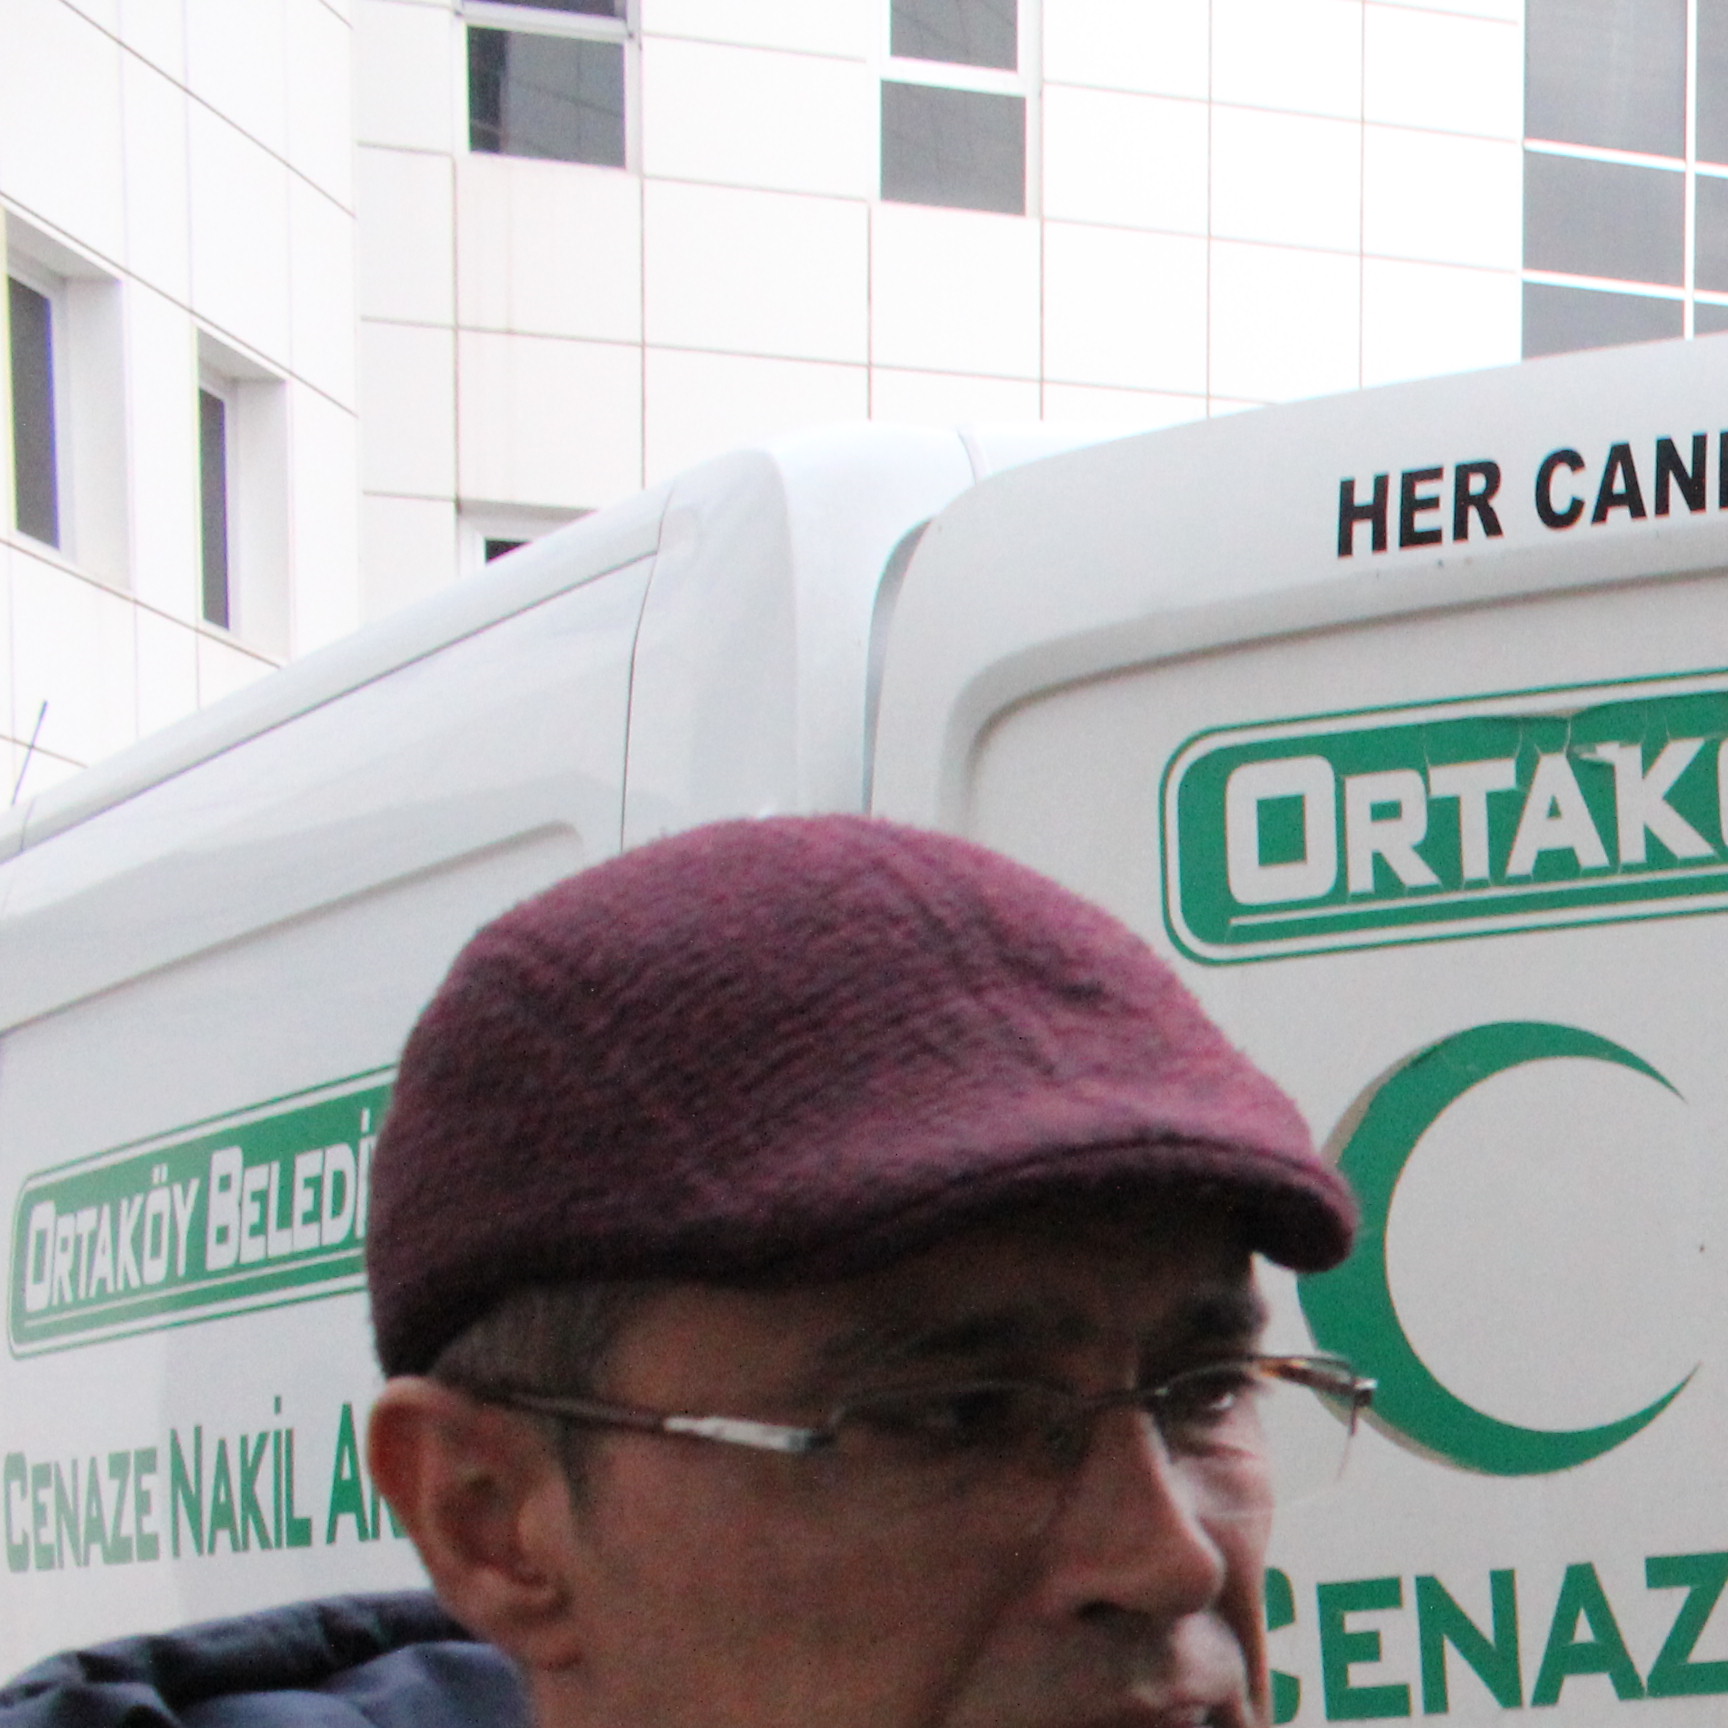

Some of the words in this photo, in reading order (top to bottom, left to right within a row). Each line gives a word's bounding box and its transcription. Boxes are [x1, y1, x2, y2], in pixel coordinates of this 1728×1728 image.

[1336, 459, 1503, 559] HER
[26, 1163, 200, 1313] ORTAKÖY
[205, 1107, 378, 1272] BELEDİ
[4, 1446, 159, 1573] CENAZE
[169, 1396, 312, 1560] NAKİL
